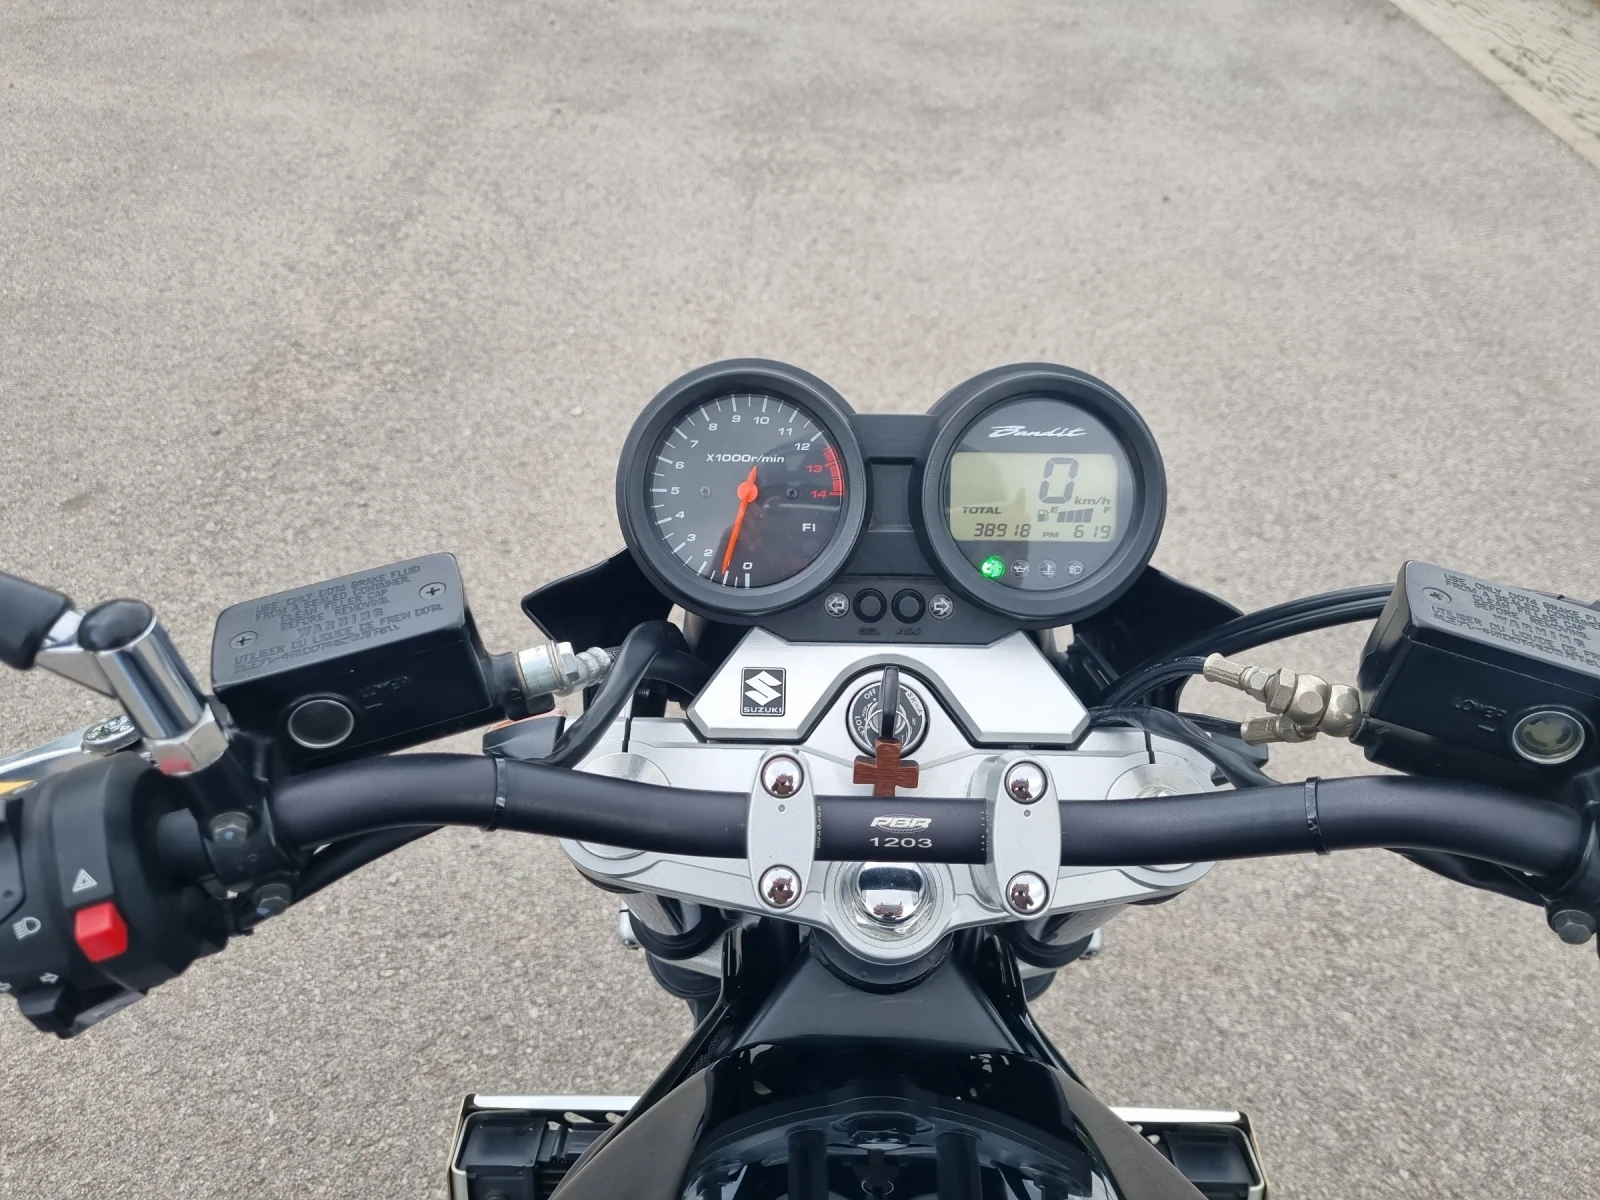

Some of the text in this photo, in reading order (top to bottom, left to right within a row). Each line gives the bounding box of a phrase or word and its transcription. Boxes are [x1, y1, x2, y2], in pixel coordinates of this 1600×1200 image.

[731, 414, 741, 423] 9
[753, 416, 770, 425] 10
[708, 423, 718, 432] 8
[778, 427, 793, 436] 11
[988, 425, 1088, 438] Bandit
[690, 439, 700, 448] 7
[794, 442, 811, 451] 12
[675, 461, 685, 470] 6
[806, 464, 823, 473] 13
[1038, 457, 1111, 505] 0 km/h
[670, 486, 680, 495] 5
[810, 490, 827, 499] 14
[675, 510, 685, 519] 4
[962, 506, 1002, 514] TOTAL
[1103, 506, 1112, 514] F
[802, 523, 817, 532] FI
[973, 523, 1032, 537] 38918
[687, 533, 696, 542] 3
[703, 548, 713, 557] 2
[742, 561, 753, 570] 0
[256, 601, 279, 613] USE
[286, 592, 313, 606] ONLY
[351, 574, 386, 589] BRAKE
[390, 565, 420, 579] FLUID
[1445, 580, 1477, 594] FROM
[1444, 573, 1466, 585] USE
[1475, 583, 1502, 595] ONLY
[1543, 602, 1579, 617] BRAKE
[281, 607, 317, 622] CLEAN
[367, 589, 388, 599] CAP
[1472, 594, 1510, 610] CLEAN
[255, 607, 287, 622] FROM
[304, 592, 347, 608] SEALED
[1474, 600, 1520, 619] BEFORE
[281, 613, 324, 631] BEFORE
[864, 688, 877, 699] OFF
[743, 706, 783, 714] SUZUKI
[870, 816, 932, 829] RBR
[869, 837, 933, 848] 1203
